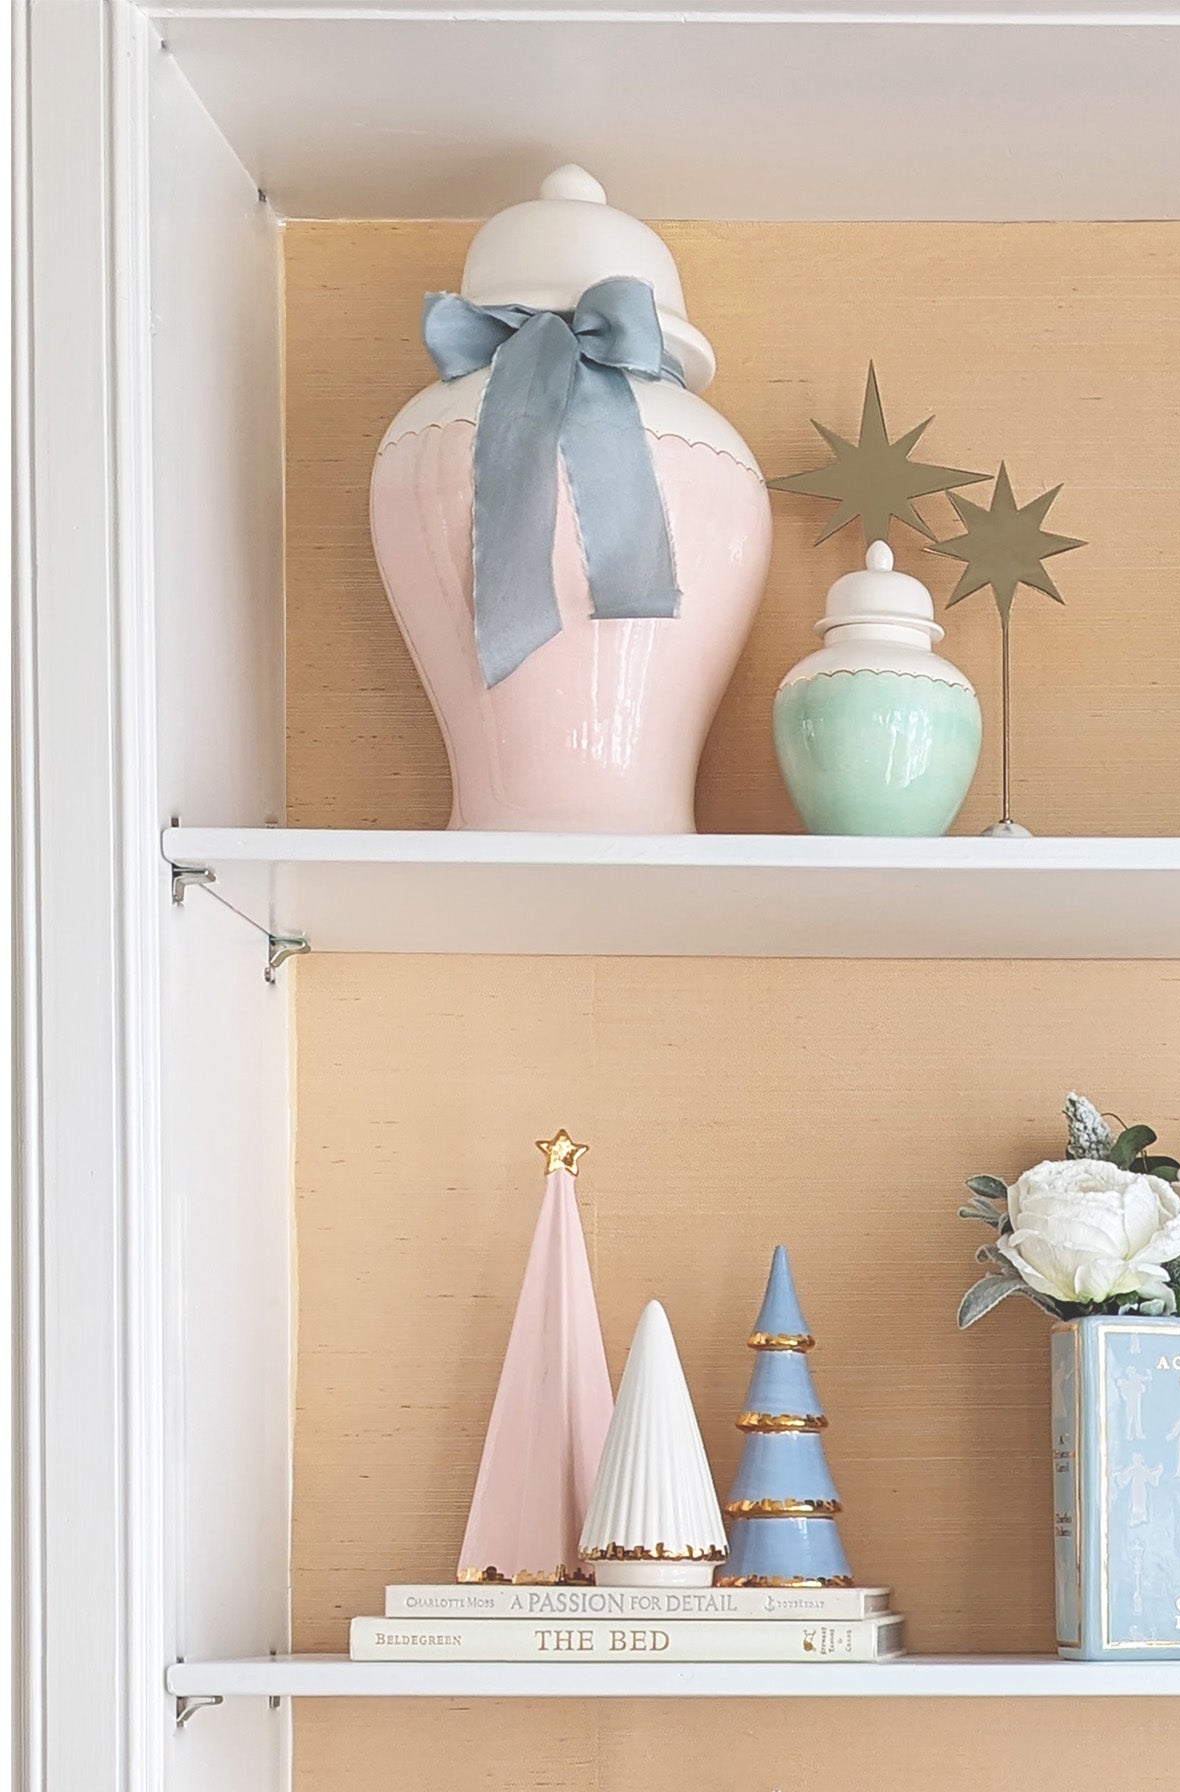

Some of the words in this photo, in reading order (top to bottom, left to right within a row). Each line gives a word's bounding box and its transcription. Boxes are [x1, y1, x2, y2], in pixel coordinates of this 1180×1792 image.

[1157, 1355, 1169, 1369] A
[406, 1596, 465, 1608] CHARLOTTE
[466, 1596, 495, 1609] MOSS
[510, 1597, 524, 1610] A
[528, 1593, 625, 1613] PASSION
[631, 1596, 662, 1611] FOR
[665, 1595, 738, 1612] DETAIL
[375, 1633, 462, 1646] BELDEGREEN
[535, 1630, 594, 1651] THE
[609, 1630, 670, 1651] BED
